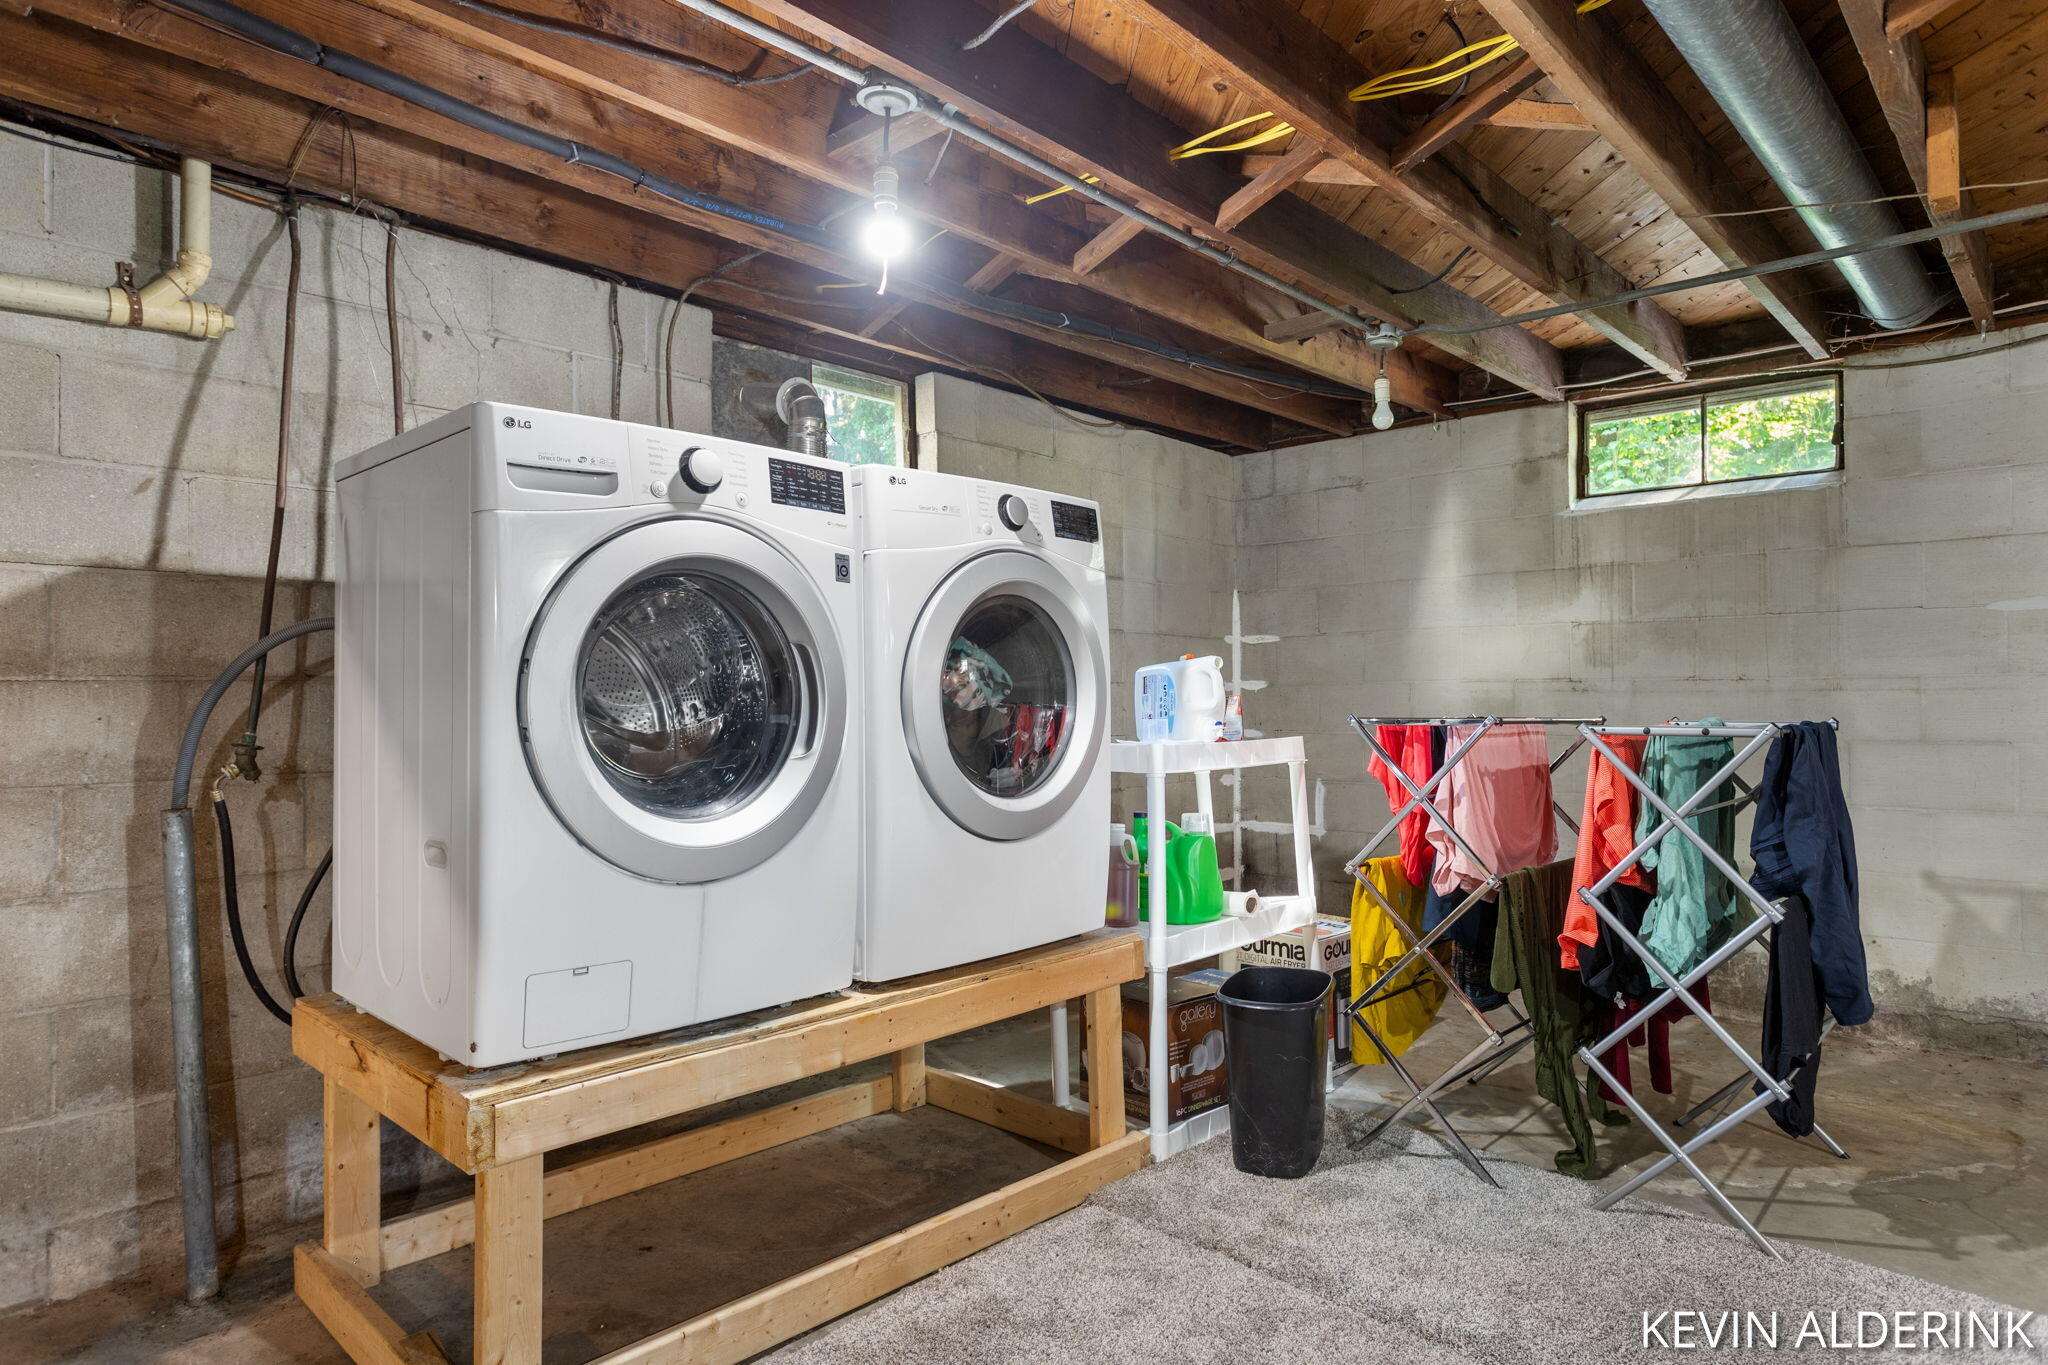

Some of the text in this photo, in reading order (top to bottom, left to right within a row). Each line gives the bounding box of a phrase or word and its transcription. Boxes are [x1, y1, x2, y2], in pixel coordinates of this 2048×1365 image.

[517, 419, 532, 429] LG
[537, 454, 571, 463] Direct Drive
[1324, 939, 1351, 961] GOU
[1244, 952, 1269, 965] DIGITAL
[1270, 957, 1282, 966] AIR
[1180, 1002, 1217, 1032] gallery
